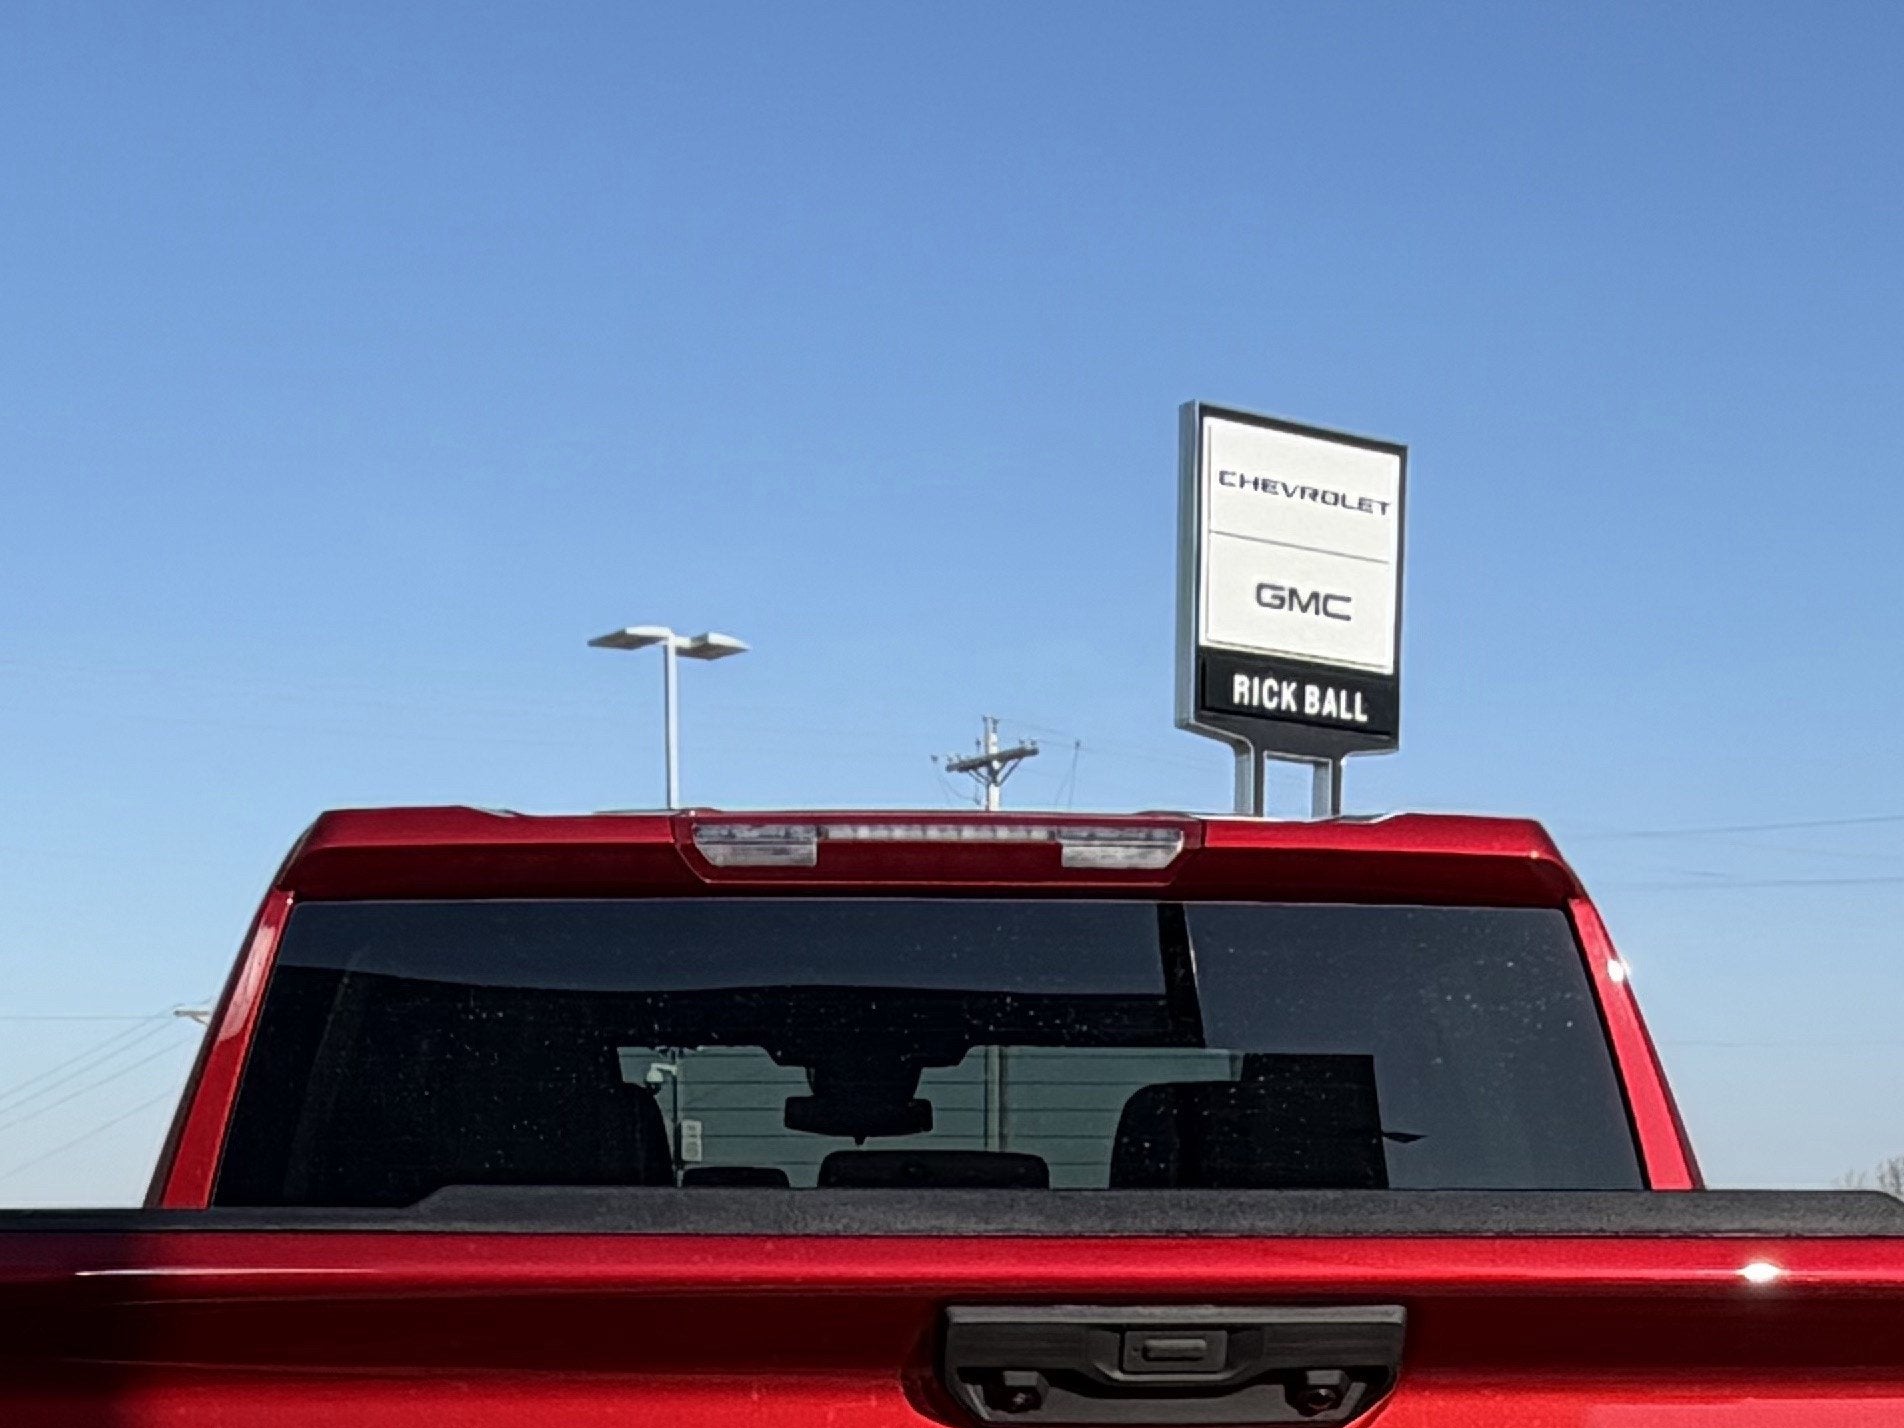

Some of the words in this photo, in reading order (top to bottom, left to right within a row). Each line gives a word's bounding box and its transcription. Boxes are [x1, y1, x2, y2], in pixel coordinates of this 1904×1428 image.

[1218, 470, 1391, 516] CHEVROLET
[1256, 582, 1352, 622] GMC
[1233, 673, 1298, 712] RICK
[1303, 683, 1368, 724] BALL
